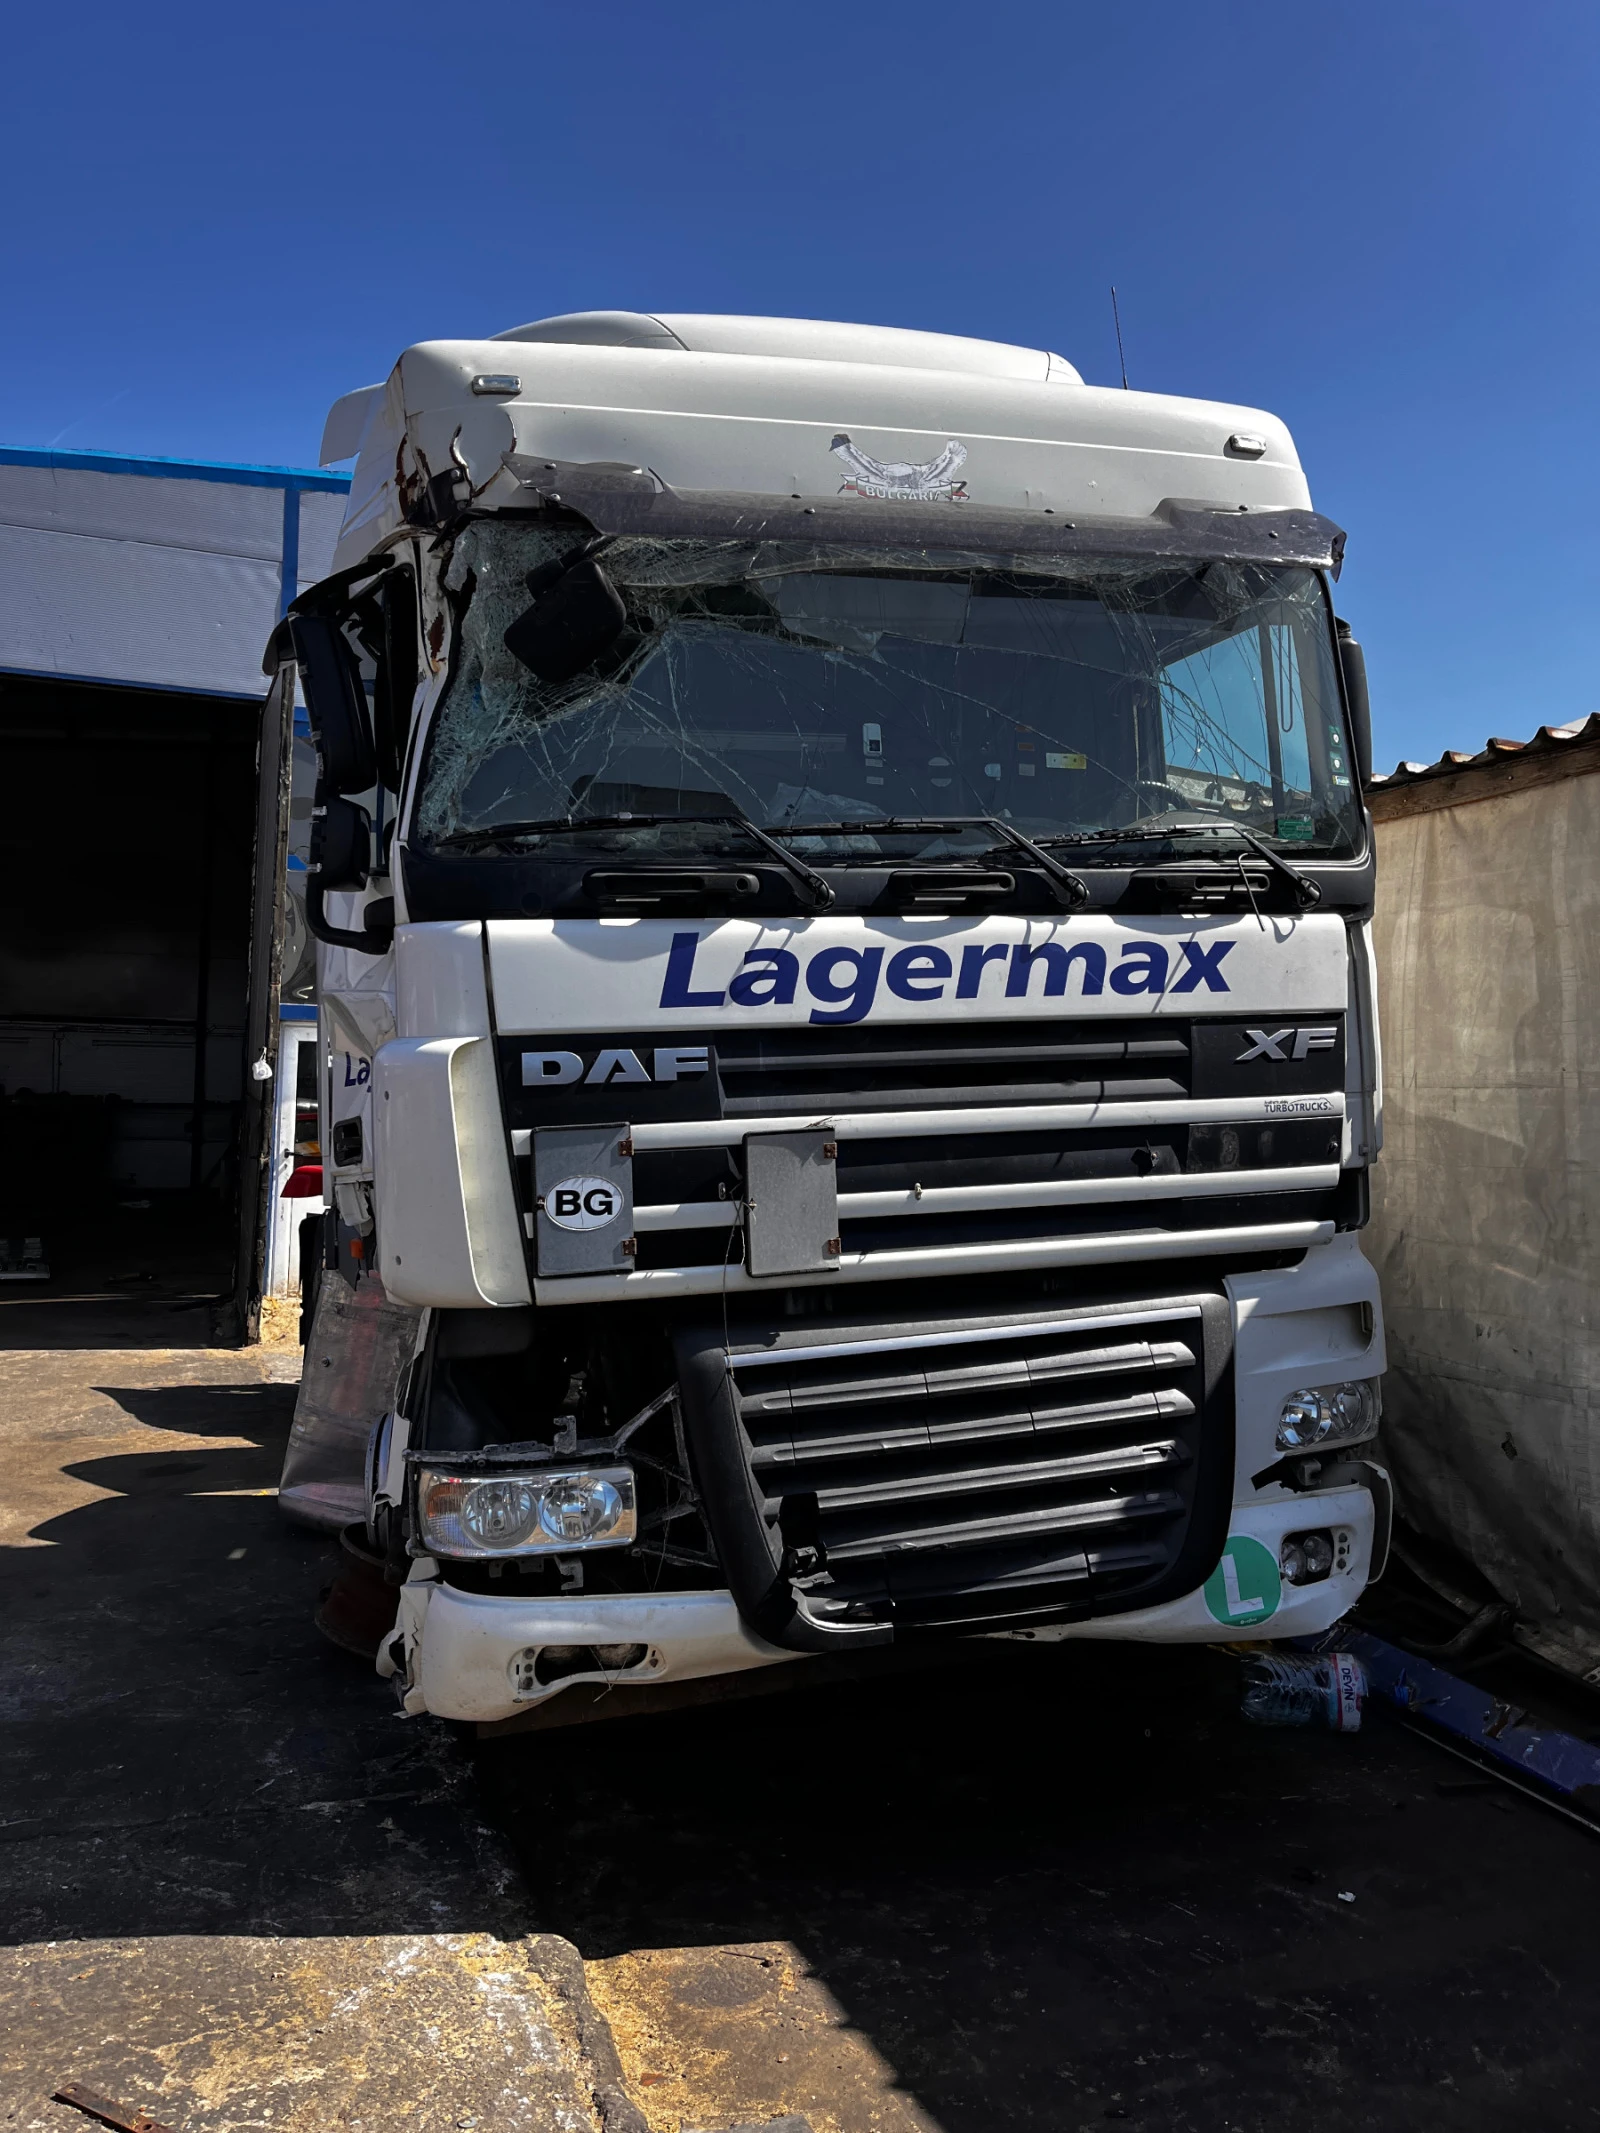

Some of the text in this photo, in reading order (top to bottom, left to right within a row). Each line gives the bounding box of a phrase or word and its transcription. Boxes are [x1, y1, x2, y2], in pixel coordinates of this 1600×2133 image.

[659, 932, 1238, 1025] Lagermax
[1234, 1026, 1338, 1062] XF
[344, 1051, 372, 1093] La
[521, 1046, 709, 1086] DAF
[1264, 1101, 1329, 1113] TURBOTRUCKS
[554, 1188, 614, 1217] BG
[1220, 1553, 1264, 1616] L
[1340, 1667, 1355, 1701] DEVIN
